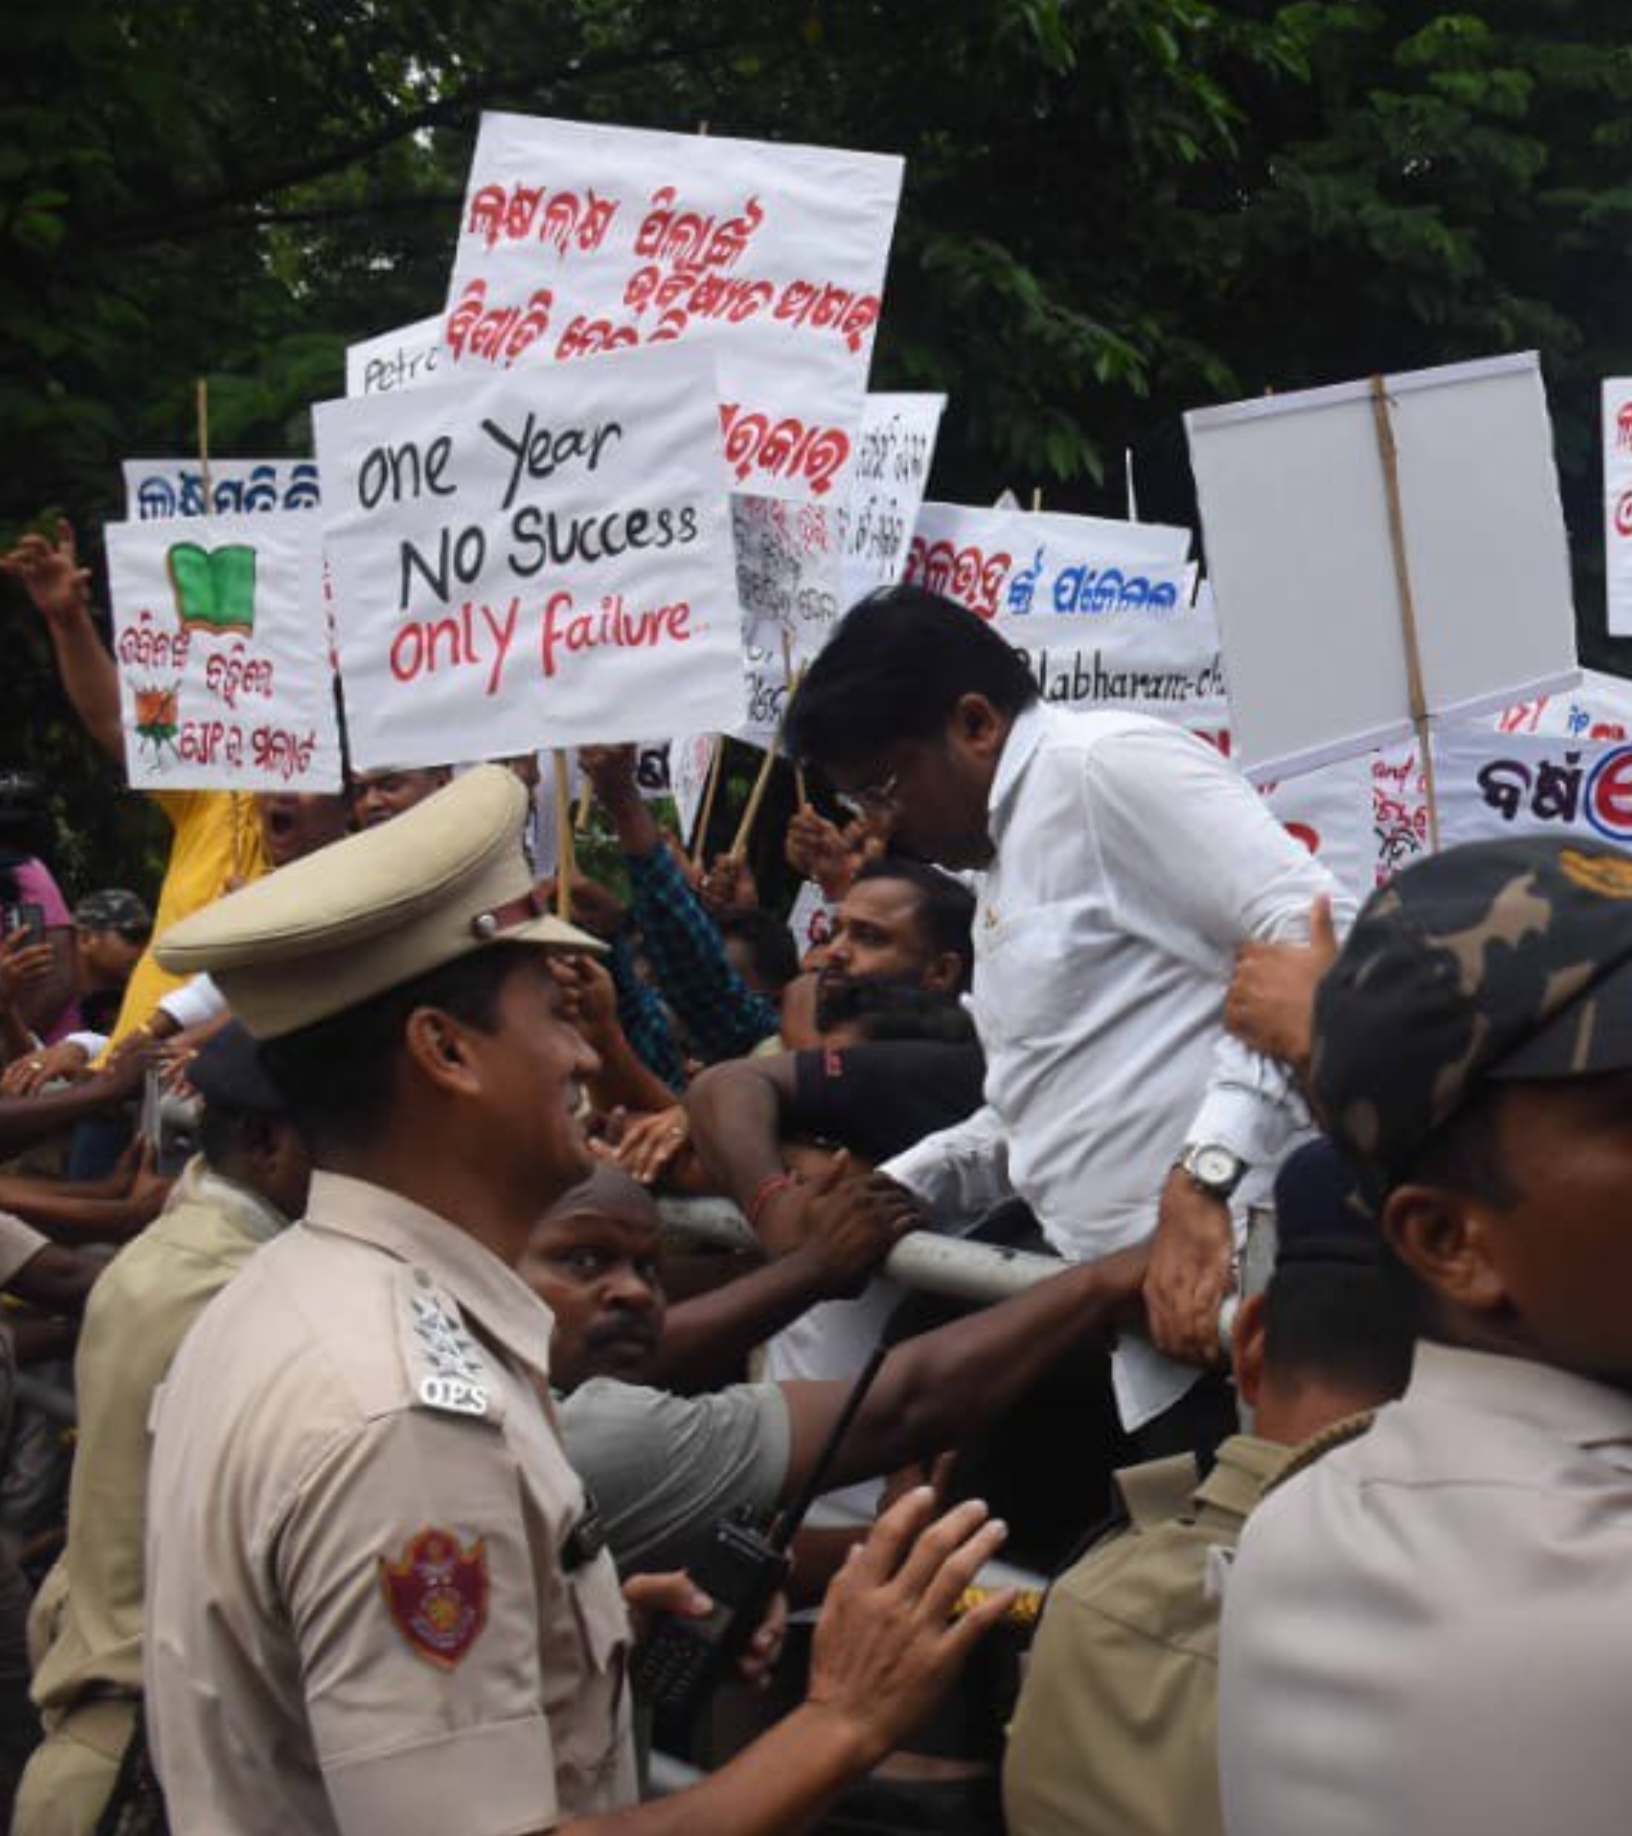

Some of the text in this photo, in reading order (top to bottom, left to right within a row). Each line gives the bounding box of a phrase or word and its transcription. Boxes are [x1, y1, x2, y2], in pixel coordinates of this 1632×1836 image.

[481, 413, 623, 511] Year
[719, 404, 850, 495] ରକାର
[508, 505, 698, 577] Success
[1477, 751, 1586, 824] ବର୍ଷ
